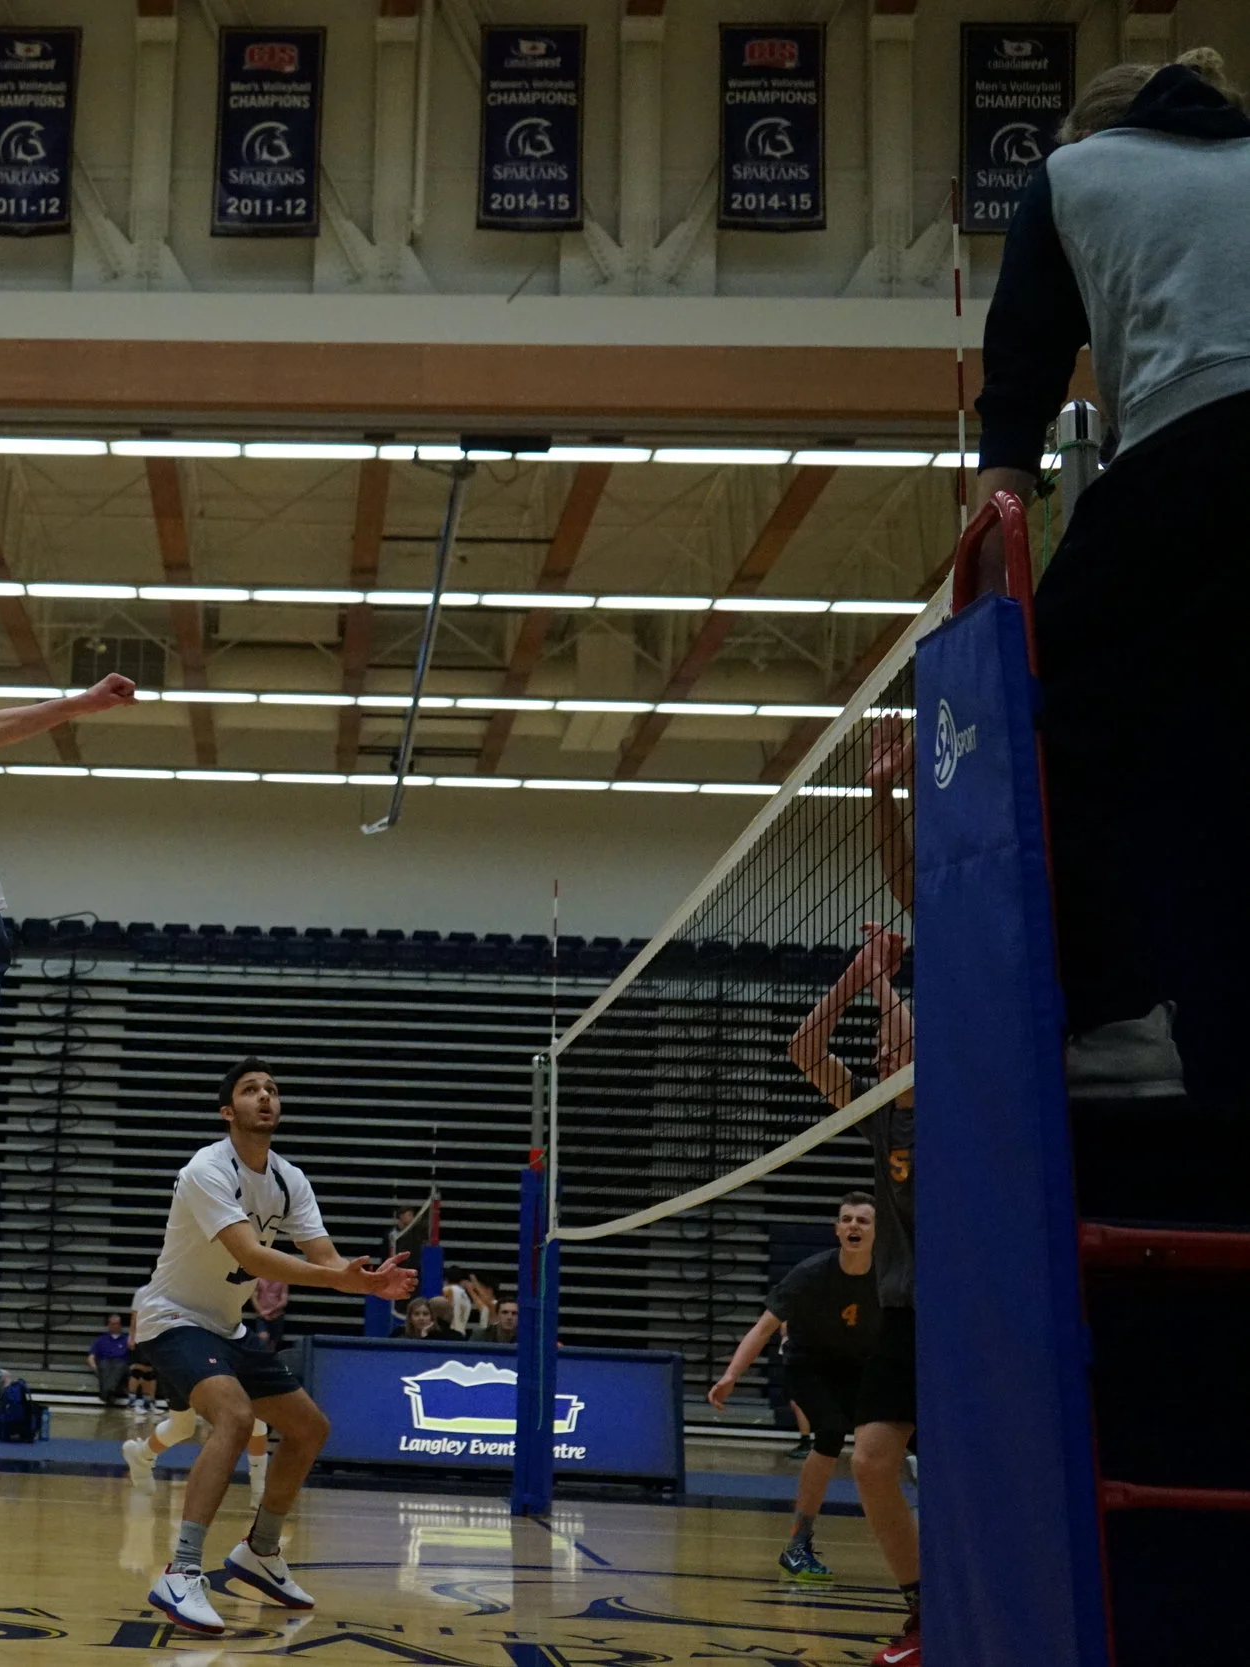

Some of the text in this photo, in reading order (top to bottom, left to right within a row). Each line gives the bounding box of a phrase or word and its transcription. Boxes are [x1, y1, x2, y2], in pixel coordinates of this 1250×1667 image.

[1010, 80, 1061, 94] Volleyball
[229, 95, 310, 109] CHAMPIONS
[486, 92, 577, 106] CHAMPIONS
[726, 92, 817, 105] CHAMPIONS
[975, 95, 1062, 109] CHAMPIONS
[227, 167, 306, 187] SPARTANS
[492, 164, 568, 181] SPARTANS
[732, 164, 811, 182] SPARTANS
[225, 197, 307, 216] 2011-12
[490, 193, 570, 211] 2014-15
[731, 193, 812, 211] 2014-15
[889, 1148, 911, 1182] 5
[841, 1304, 859, 1327] 4
[400, 1436, 587, 1460] Langley Event ntre
